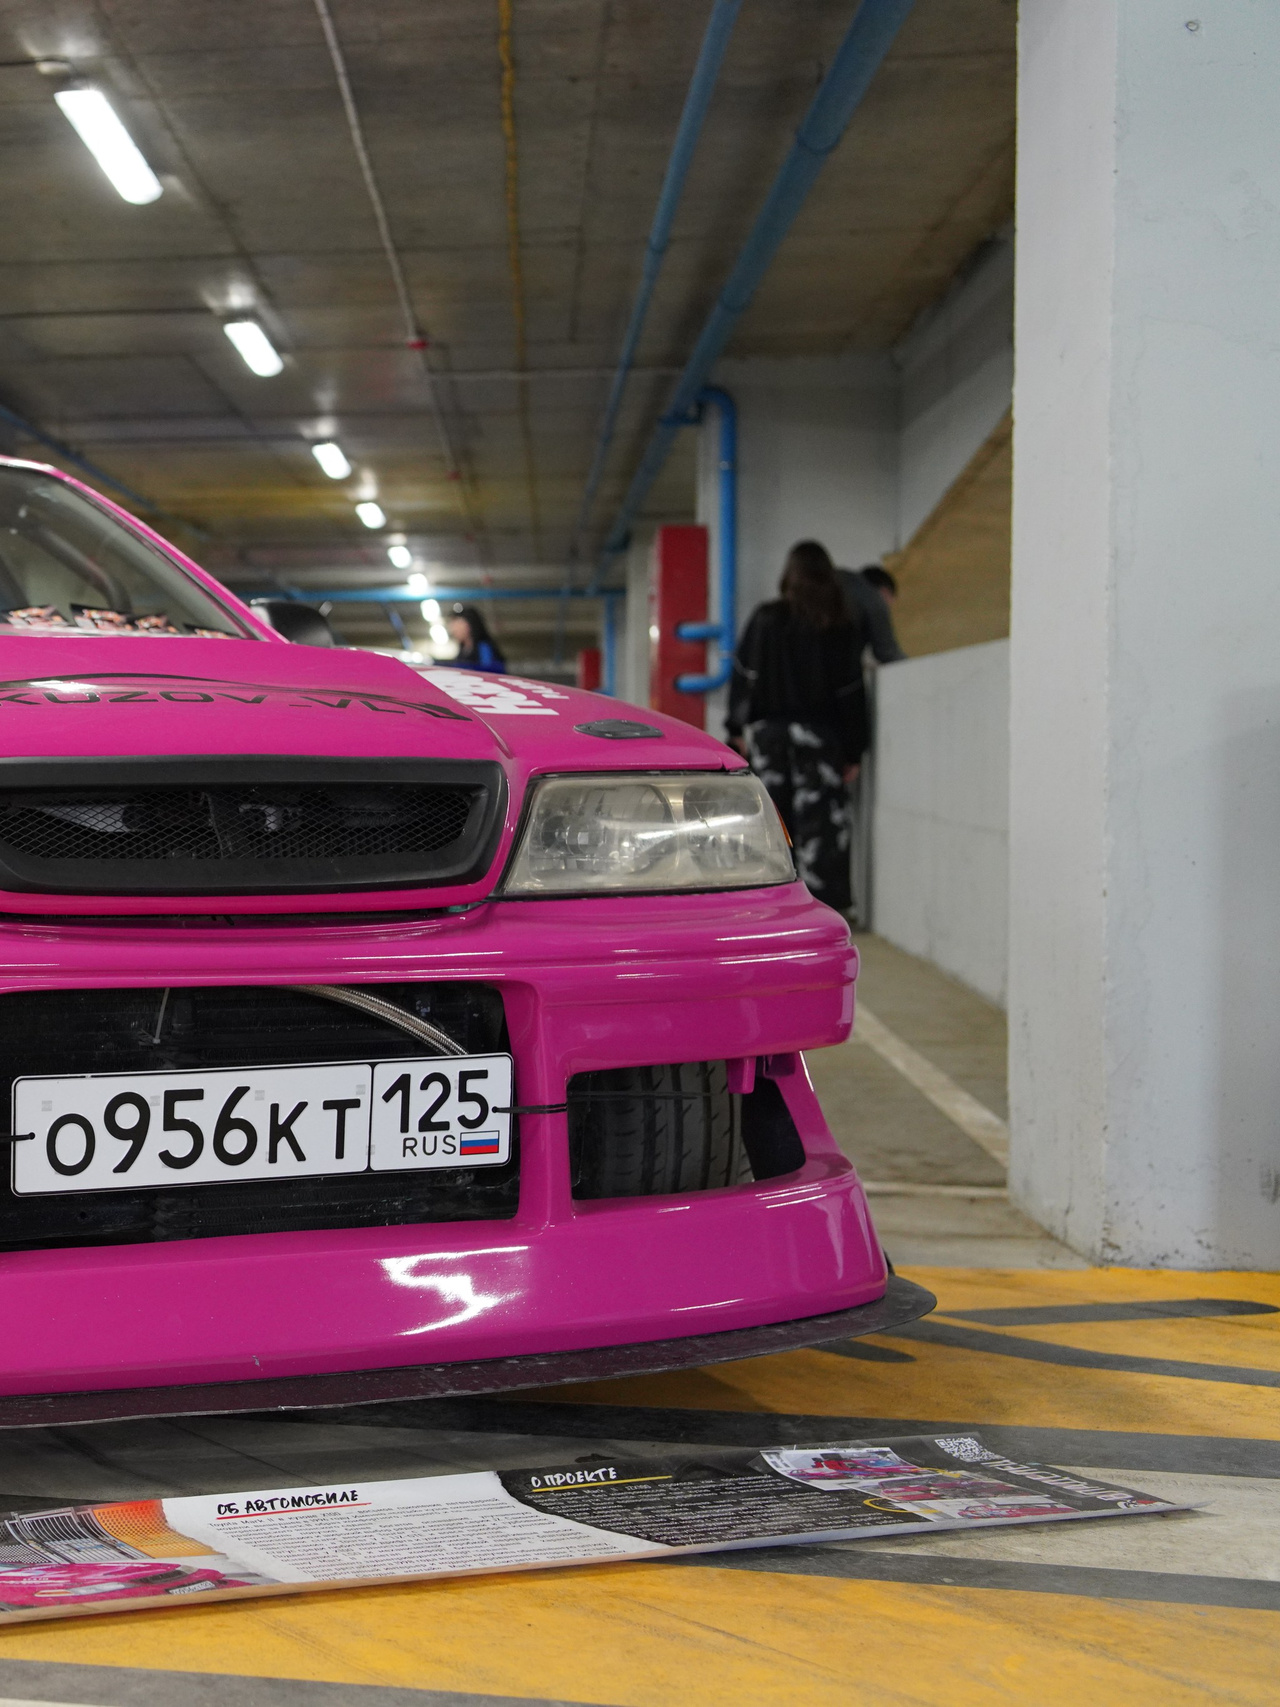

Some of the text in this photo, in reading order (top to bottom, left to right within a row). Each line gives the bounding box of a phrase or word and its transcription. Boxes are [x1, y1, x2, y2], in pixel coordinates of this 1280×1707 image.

[381, 1069, 490, 1134] 125
[402, 1134, 457, 1158] RUS
[531, 1467, 617, 1488] О ПРОЕКТЕ
[217, 1502, 239, 1515] ОБ
[245, 1490, 359, 1514] АВТОМОБИЛЕ
